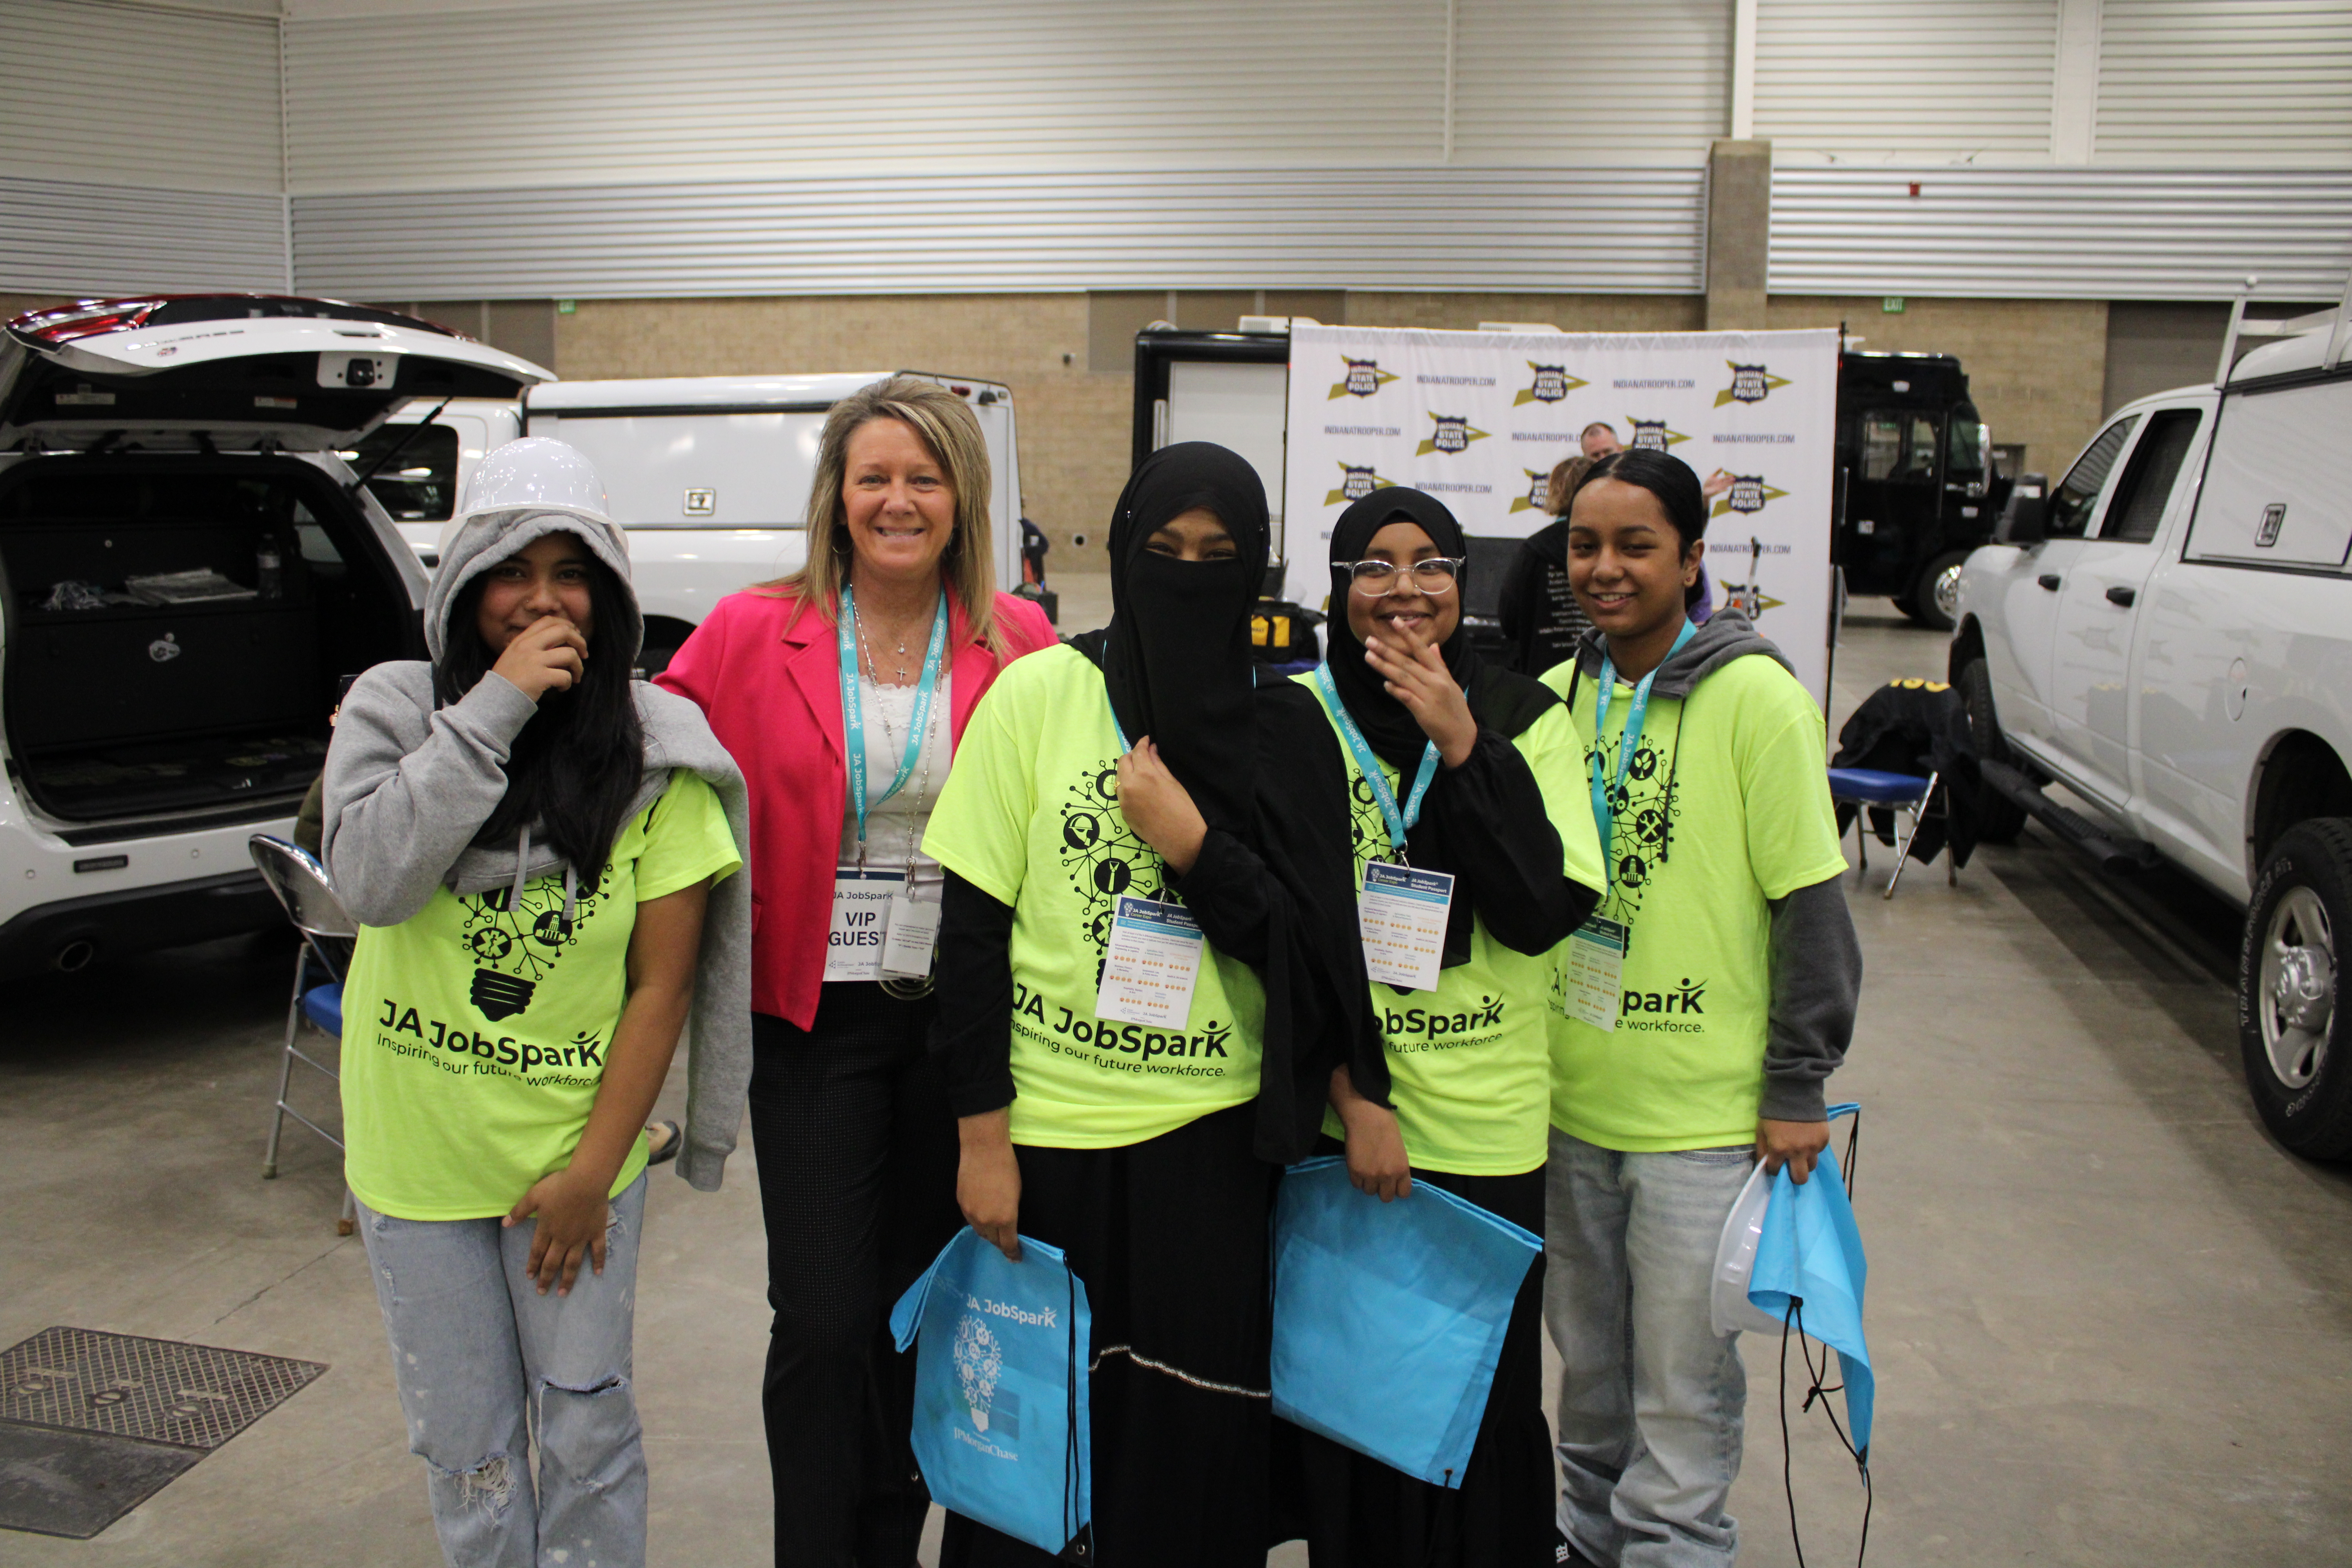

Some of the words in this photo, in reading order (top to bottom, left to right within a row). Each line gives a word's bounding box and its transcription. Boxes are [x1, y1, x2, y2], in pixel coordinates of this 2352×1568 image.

[1537, 371, 1564, 379] INDIANA
[1737, 372, 1763, 380] INDIANA
[1417, 375, 1496, 387] INDIANATROOPER.COM
[1538, 379, 1561, 388] STATE
[1613, 379, 1695, 389] INDIANATROOPER.COM
[1737, 380, 1760, 388] STATE
[1349, 382, 1376, 392] POLICE
[1535, 388, 1564, 397] POLICE
[1734, 388, 1764, 397] POLICE
[1325, 425, 1401, 437] INDIANATROOPER.COM
[1438, 431, 1461, 439] STATE
[1636, 426, 1664, 435] INDIANA
[1512, 432, 1581, 443] INDIANATROOPER.C
[1637, 435, 1662, 444] STATE
[1713, 434, 1795, 444] INDIANATROOPER.COM
[1436, 439, 1465, 448] POLICE
[1348, 480, 1372, 488] STATE
[1415, 482, 1492, 494] NDIANATROOPER.COM
[1734, 481, 1761, 490] INDIANA
[1735, 490, 1759, 499] STATE
[1731, 499, 1762, 508] POLICE
[1710, 544, 1791, 554] INDIANATROER.COM
[927, 659, 936, 671] JA
[846, 673, 854, 685] JA
[1326, 682, 1335, 694] JA
[1600, 695, 1608, 706] JA
[911, 734, 920, 746] JA
[1626, 733, 1635, 745] JA
[1358, 742, 1367, 753] JA
[853, 753, 861, 766] JA
[1415, 783, 1425, 793] JA
[1389, 809, 1398, 821] JA
[1405, 795, 1419, 828] JobSpa
[846, 912, 876, 926] VIP
[828, 931, 887, 946] GUEST
[1013, 982, 1045, 1025] JA
[379, 998, 423, 1038] JA
[1628, 1020, 1705, 1033] workforce.
[1011, 1018, 1060, 1053] nspiring
[1065, 1045, 1089, 1062] our
[1094, 1054, 1142, 1073] future
[1147, 1064, 1226, 1077] workforce.
[1389, 1041, 1429, 1053] future
[377, 1033, 440, 1067] Inspiring
[442, 1061, 468, 1074] our
[967, 1293, 981, 1312] JA
